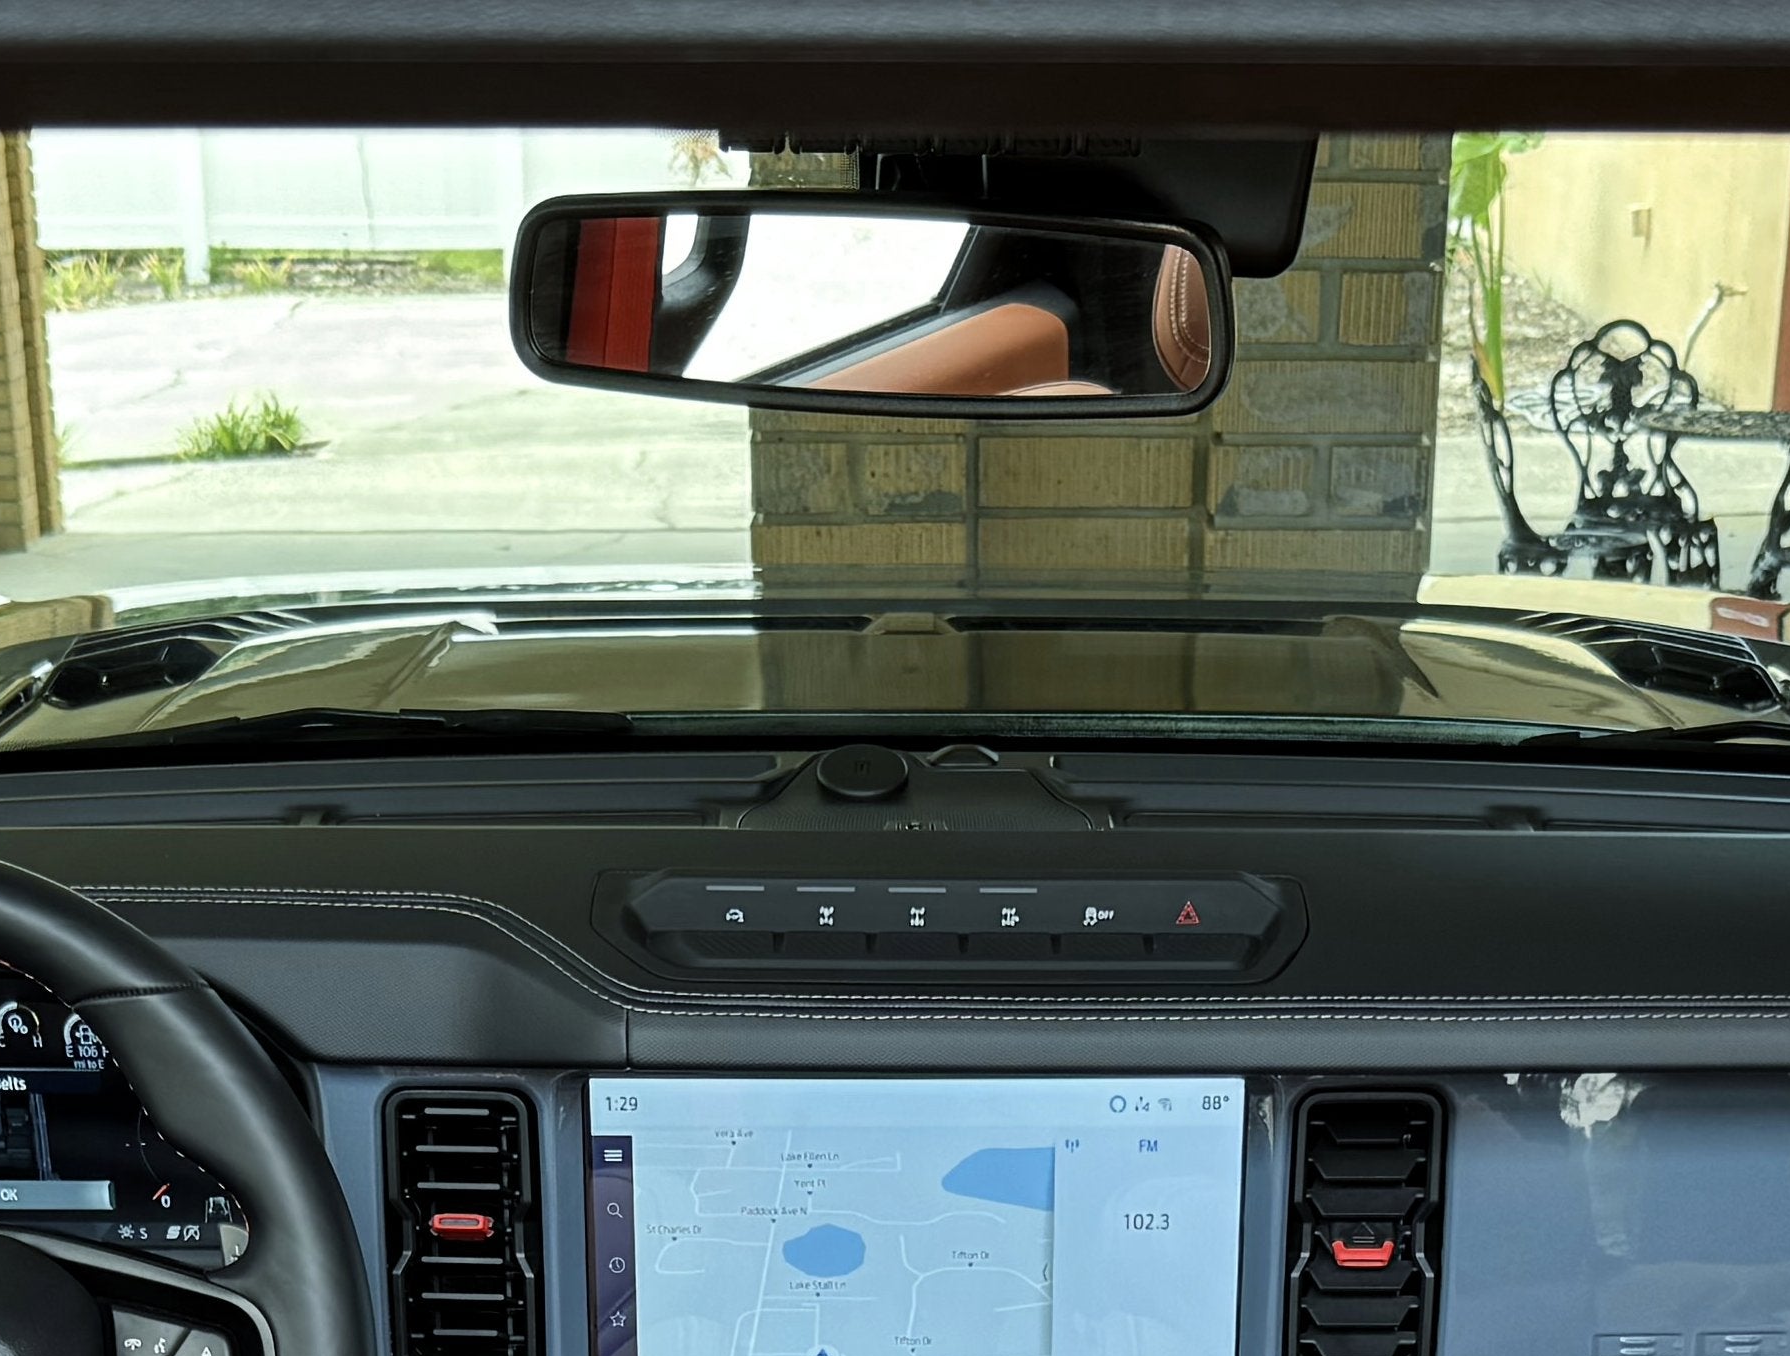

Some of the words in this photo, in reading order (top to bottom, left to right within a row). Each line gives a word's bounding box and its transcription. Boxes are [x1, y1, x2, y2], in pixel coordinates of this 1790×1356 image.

[605, 1096, 638, 1112] 1:29
[1139, 1139, 1158, 1152] FM
[0, 1189, 19, 1202] OK
[1123, 1213, 1170, 1231] 102.3
